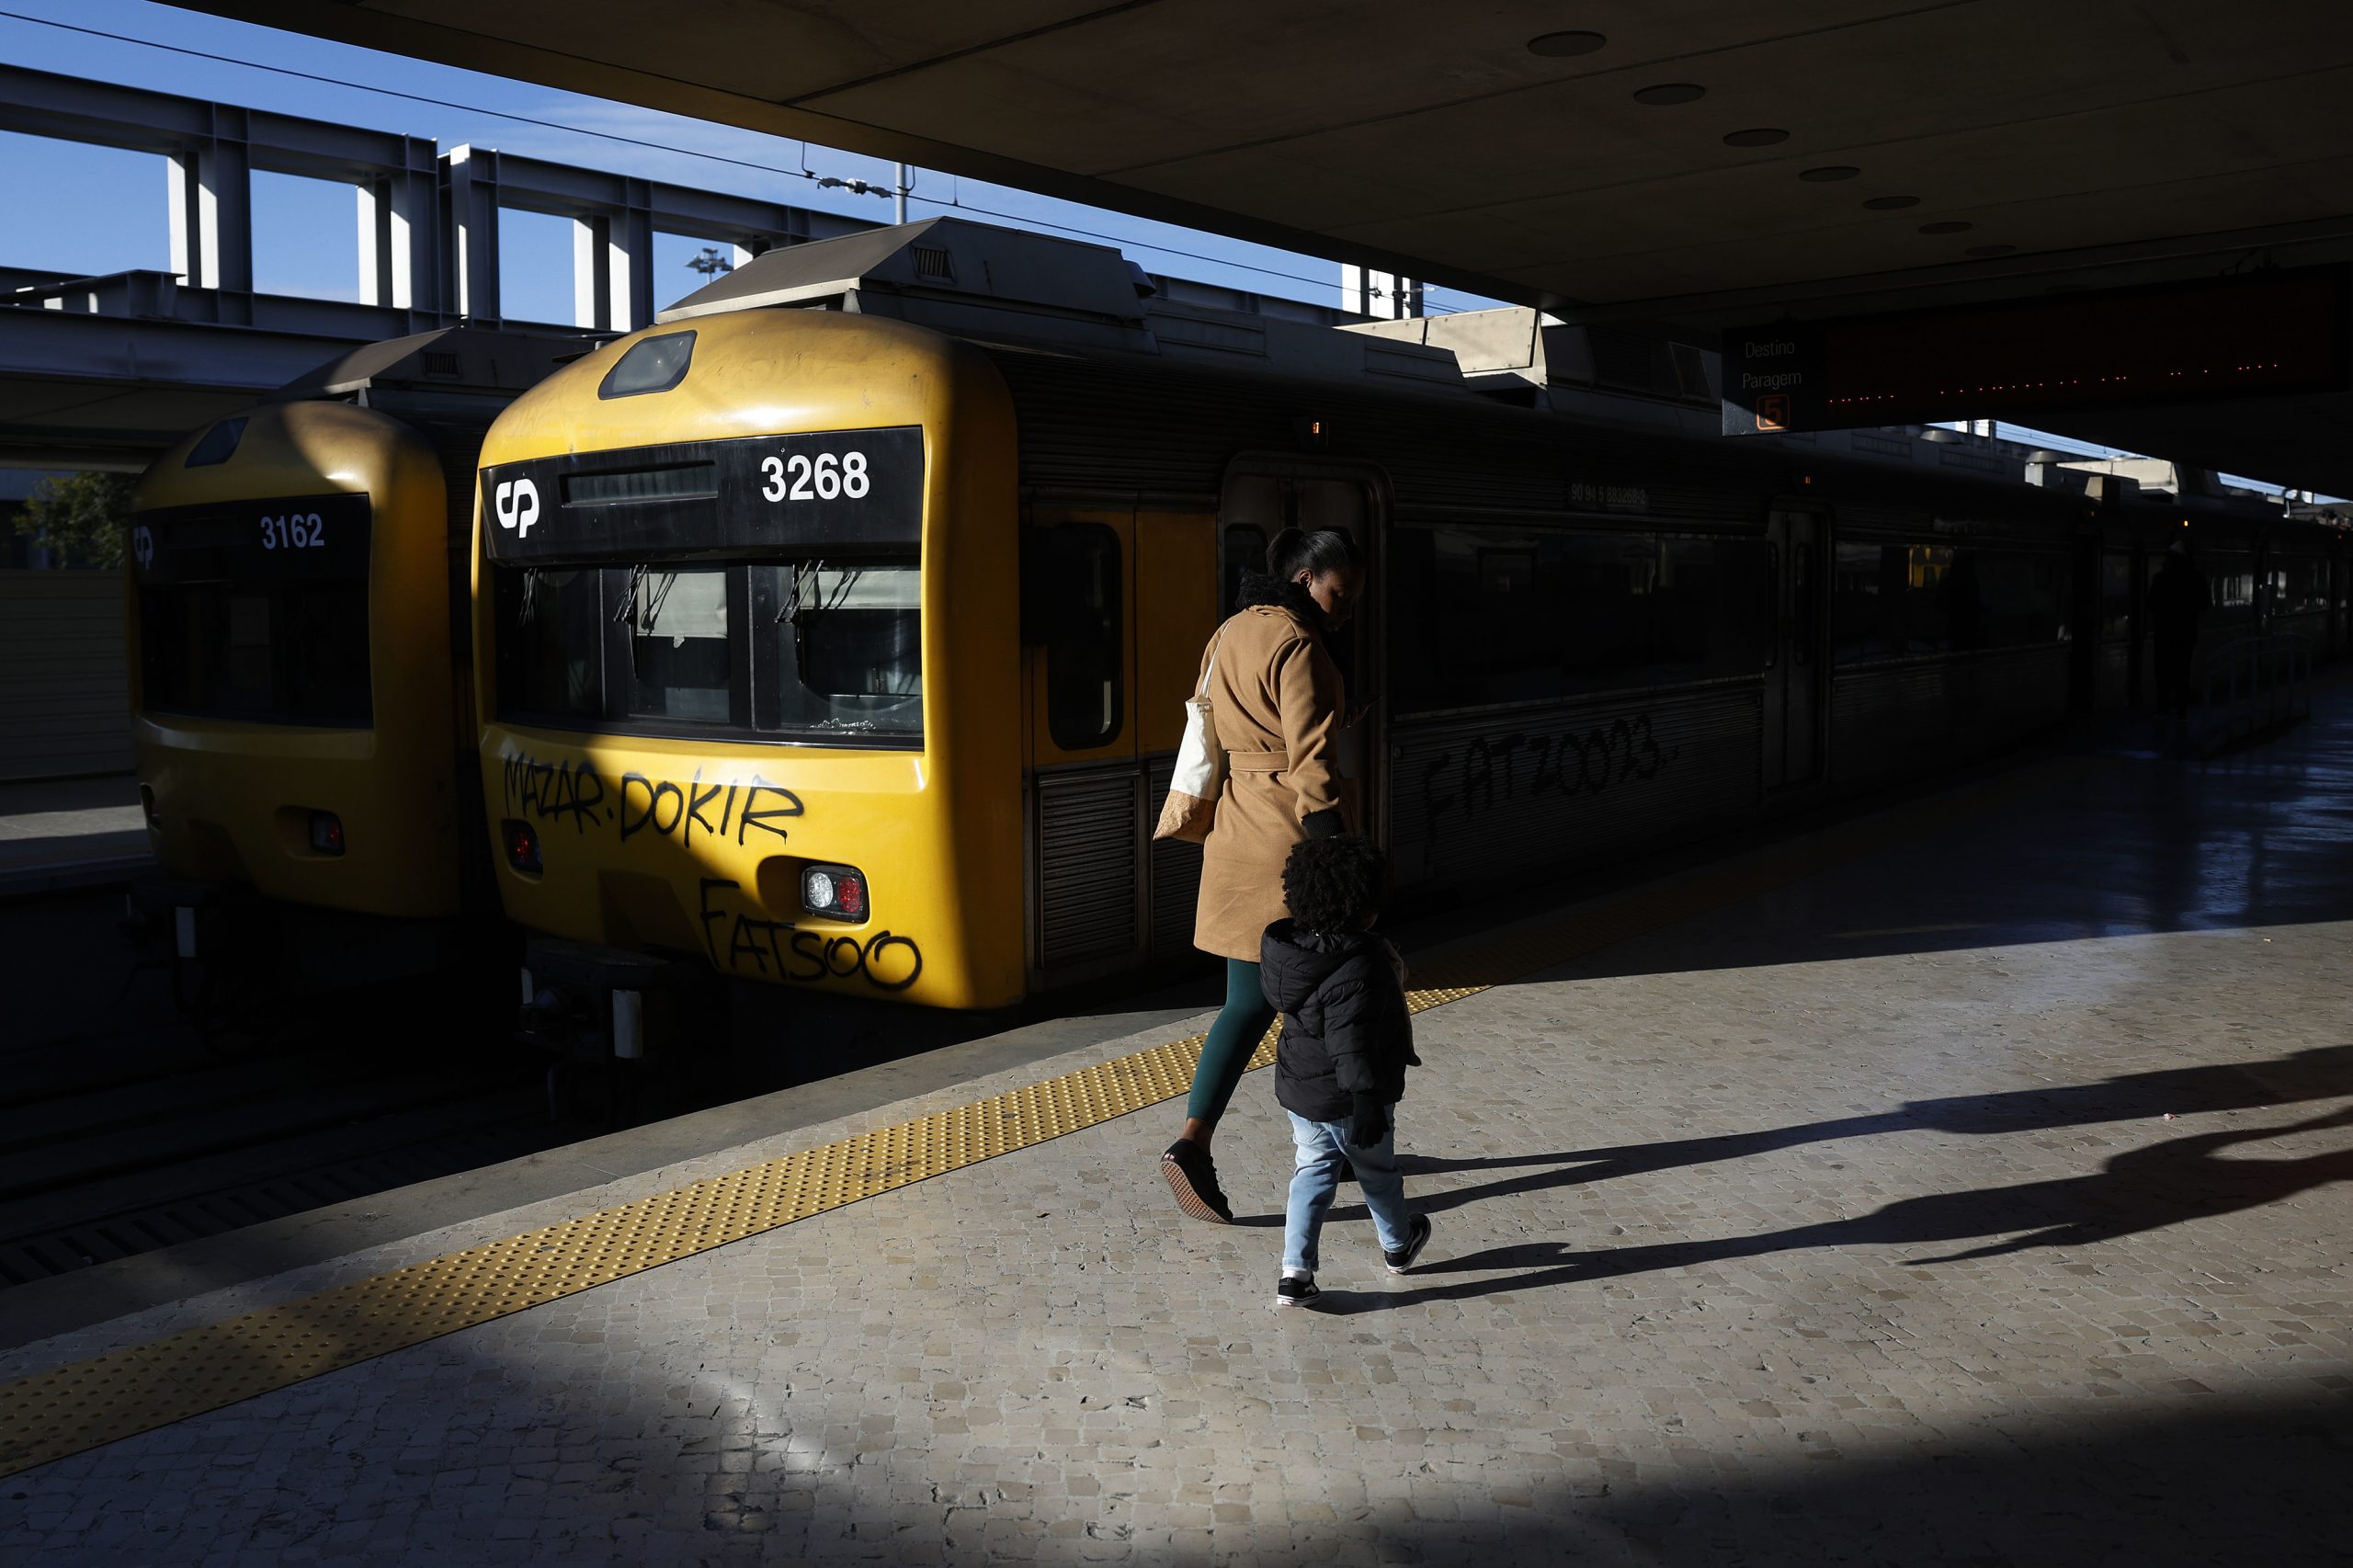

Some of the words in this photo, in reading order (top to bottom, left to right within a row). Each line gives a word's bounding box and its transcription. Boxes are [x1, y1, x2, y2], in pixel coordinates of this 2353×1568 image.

[1745, 338, 1795, 358] Destino
[1742, 371, 1802, 391] Paragem
[1764, 397, 1783, 426] 5
[760, 450, 870, 503] 3268
[1572, 483, 1583, 501] 90
[1585, 484, 1596, 502] 94
[1598, 485, 1604, 503] 5
[259, 512, 325, 551] 3162
